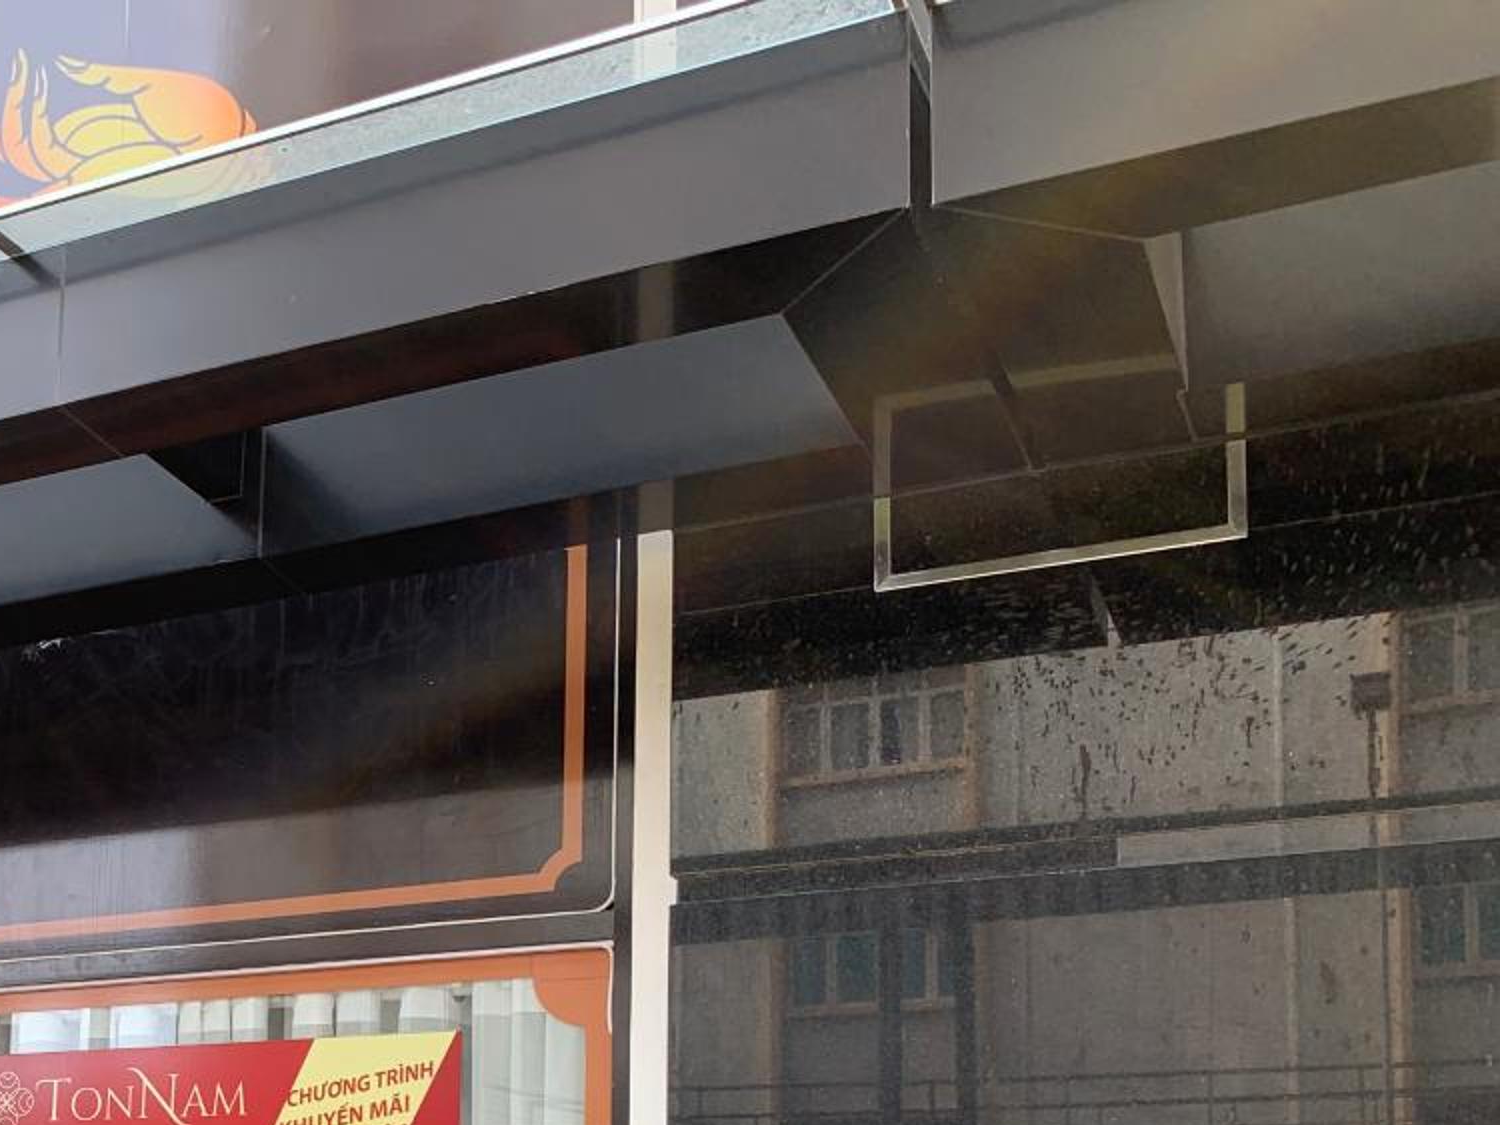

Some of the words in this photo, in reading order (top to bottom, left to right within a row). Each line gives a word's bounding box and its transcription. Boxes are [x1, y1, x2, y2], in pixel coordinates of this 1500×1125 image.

[286, 1075, 370, 1107] CHƯƠNG
[375, 1060, 434, 1088] TRÌNH
[370, 1095, 410, 1121] MÃI
